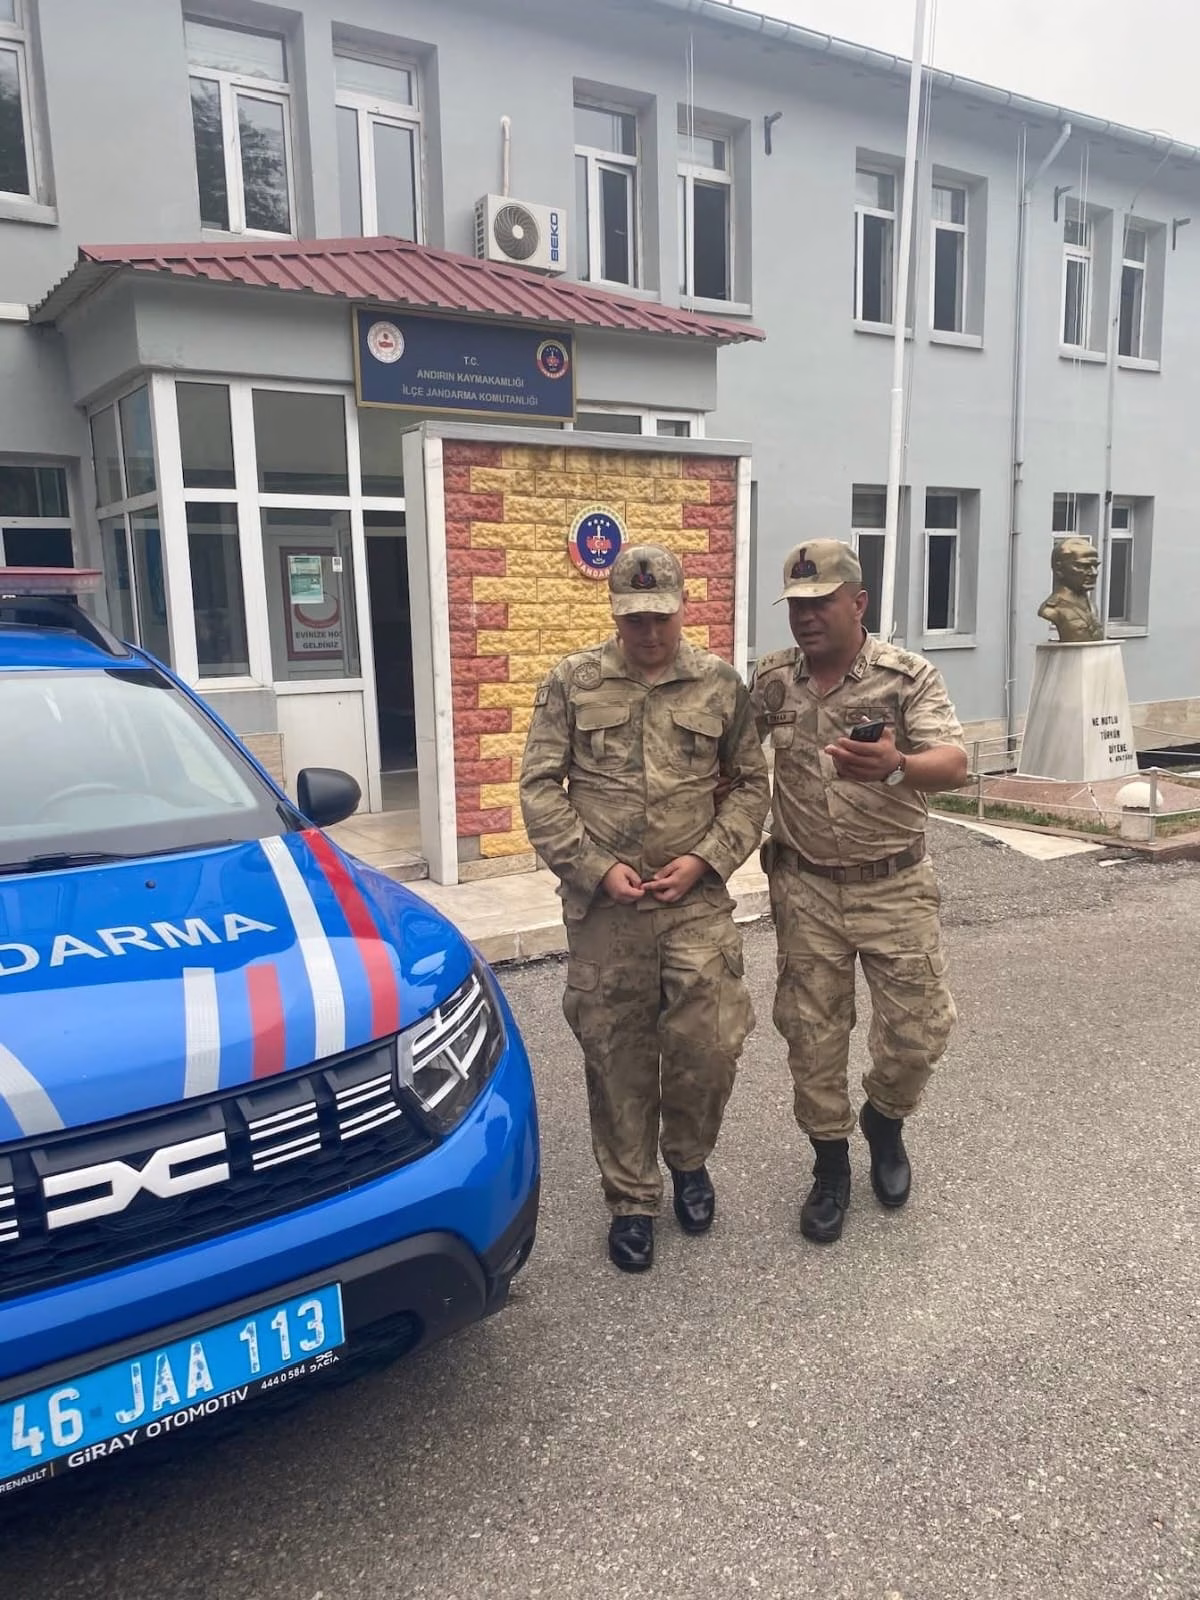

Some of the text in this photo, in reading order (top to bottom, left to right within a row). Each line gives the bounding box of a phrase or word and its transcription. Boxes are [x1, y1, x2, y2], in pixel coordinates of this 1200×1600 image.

[551, 213, 559, 262] BEKO
[463, 356, 480, 366] T.C.
[416, 369, 524, 387] ANDIRIN KAYMAKAMLIĞI
[402, 384, 538, 406] İLÇE JANDARMA KOMUTANLIĞI
[12, 1299, 325, 1457] 46 JAA 113
